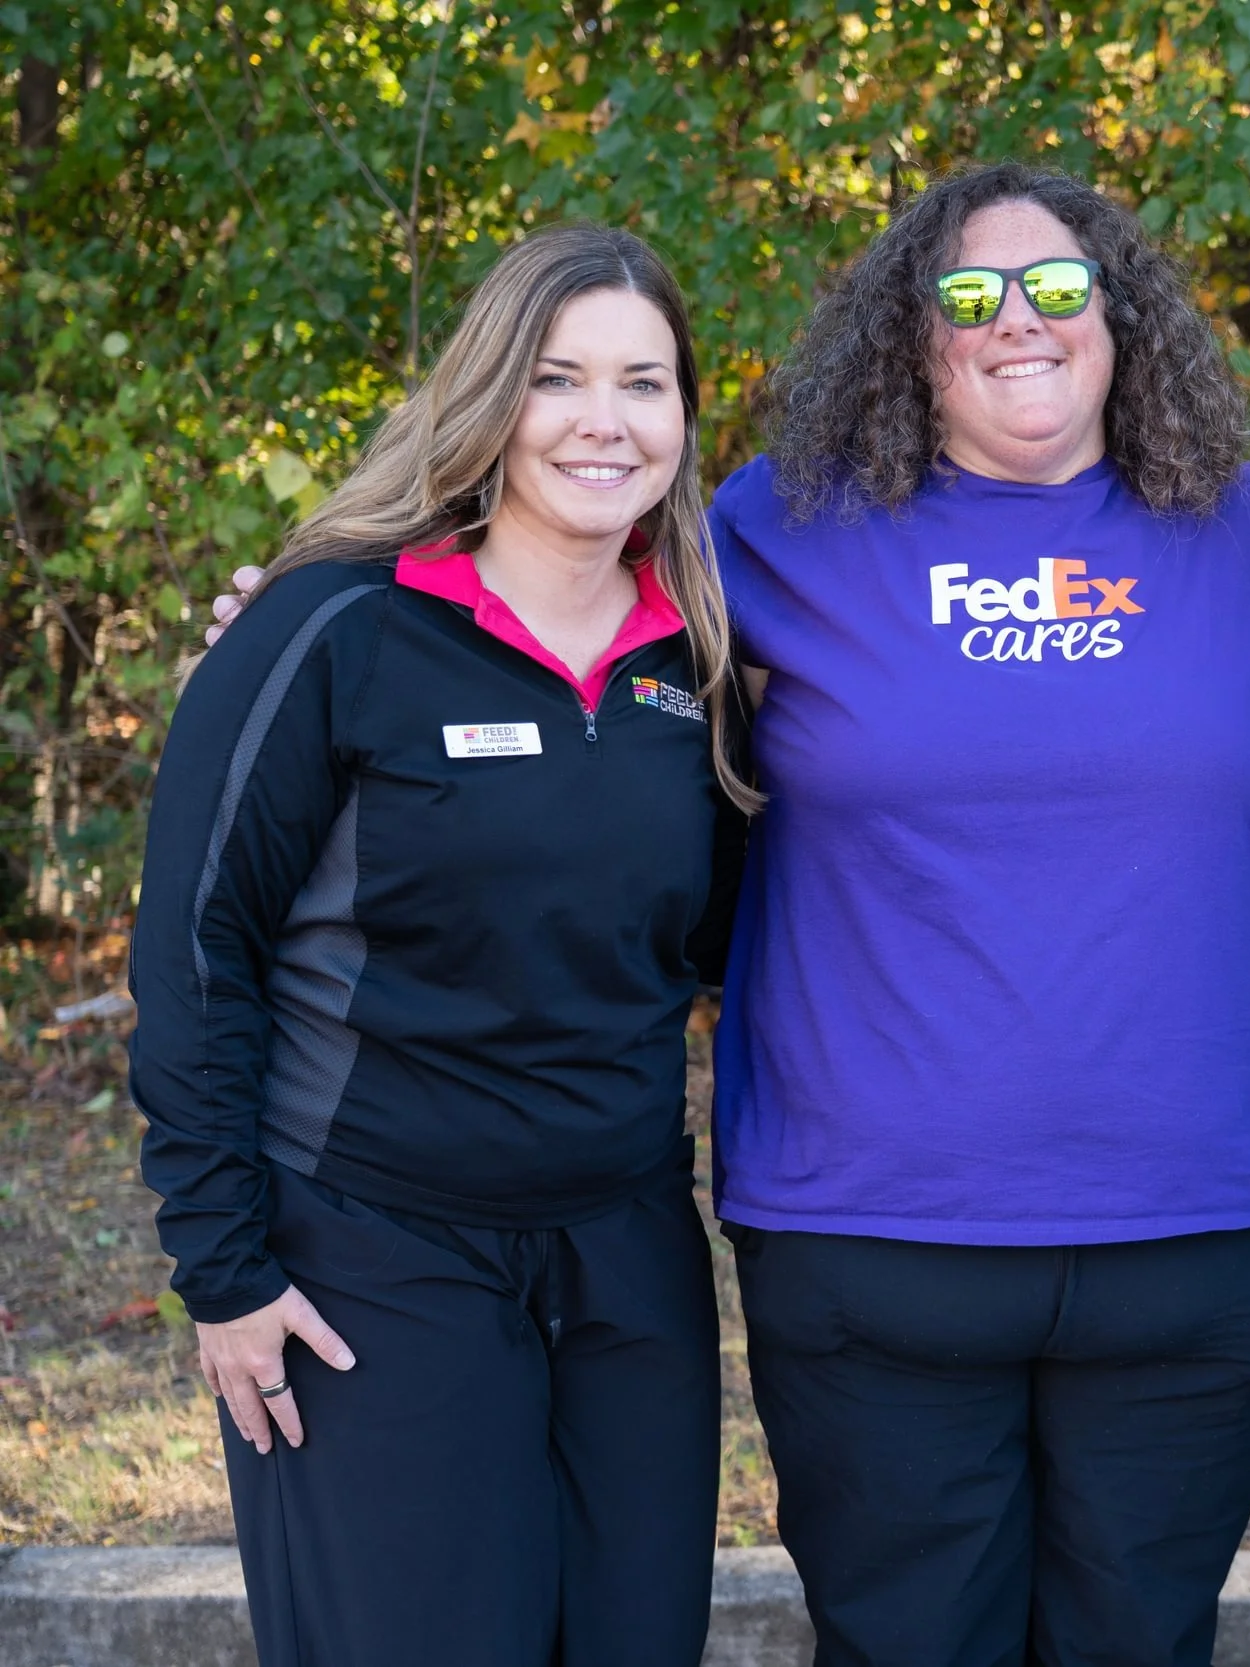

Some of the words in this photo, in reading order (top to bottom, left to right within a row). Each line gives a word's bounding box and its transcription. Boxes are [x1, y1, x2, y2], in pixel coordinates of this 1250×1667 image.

[930, 557, 1146, 625] FedEx
[960, 619, 1124, 662] cares
[660, 682, 696, 708] FEED
[482, 726, 512, 737] FEED
